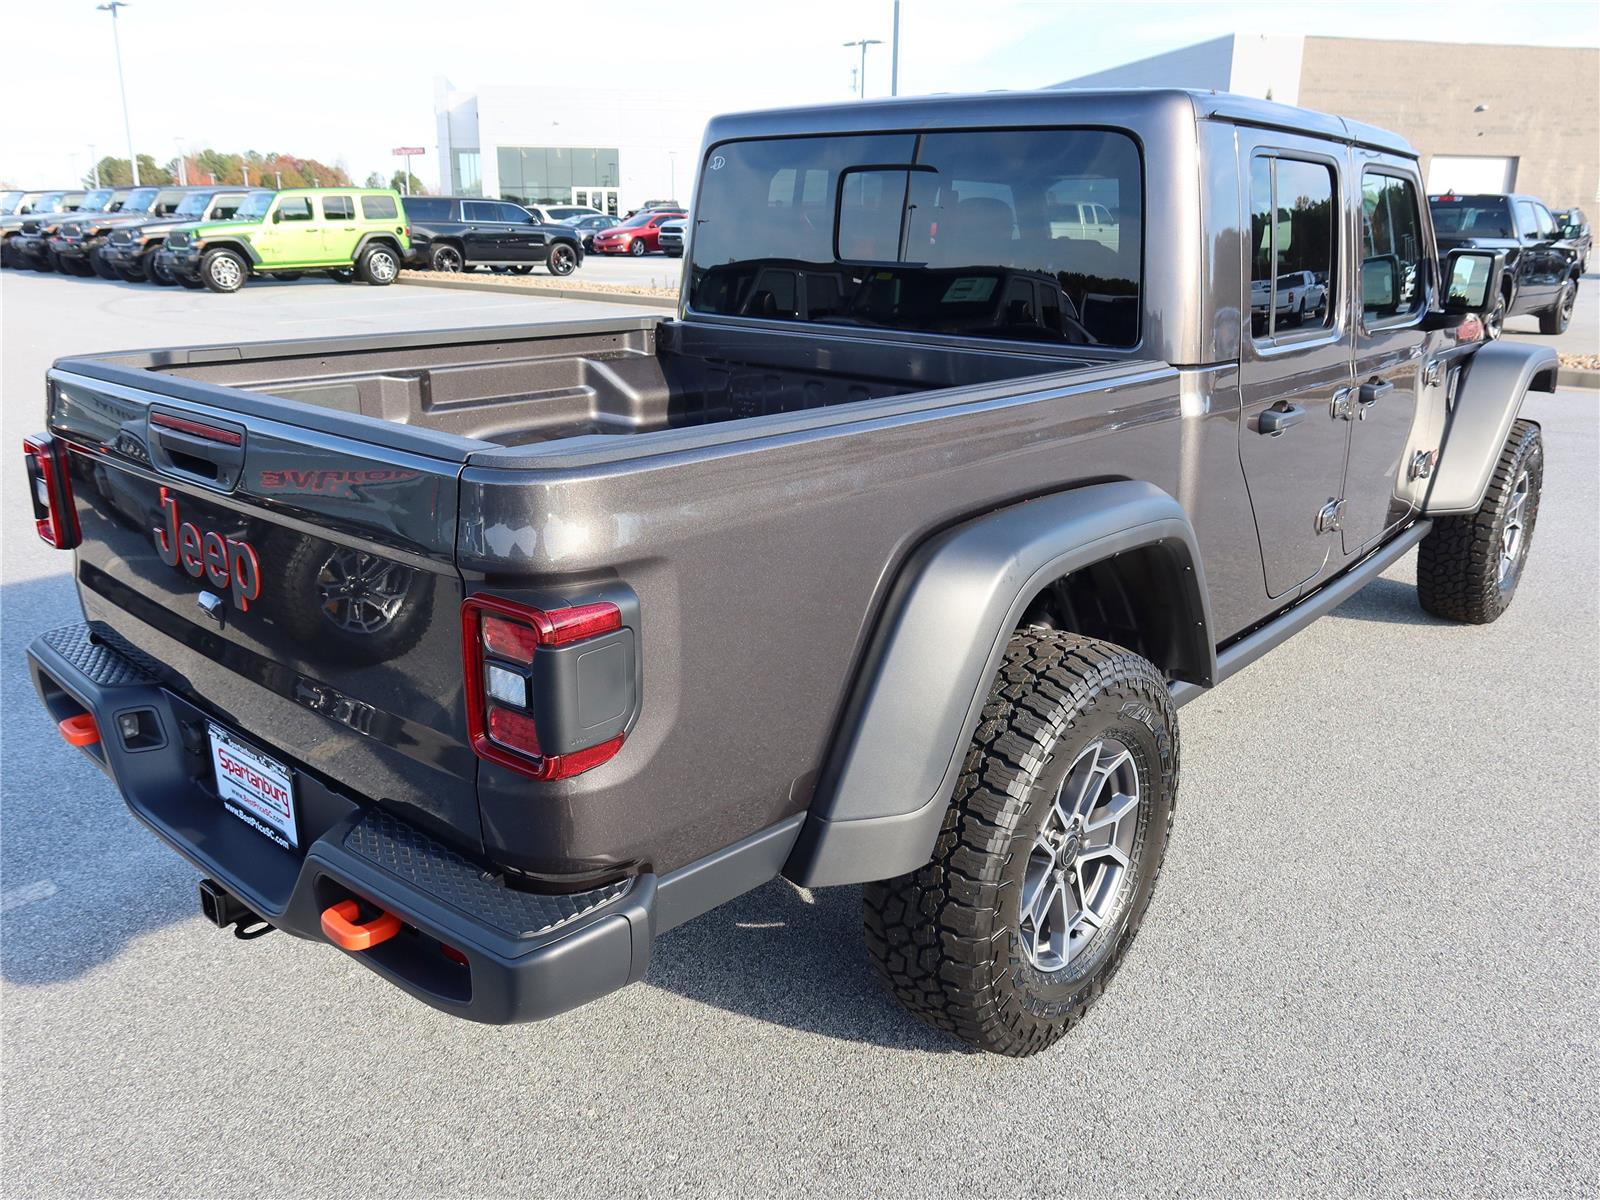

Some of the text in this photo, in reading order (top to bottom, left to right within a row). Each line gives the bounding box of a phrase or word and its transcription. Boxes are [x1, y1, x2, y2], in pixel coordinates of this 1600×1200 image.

[153, 486, 261, 612] Jeep
[217, 748, 290, 818] Spartanburg
[231, 788, 285, 826] www.BestPriceSC.com
[224, 802, 290, 849] www.BestPriceSC.com
